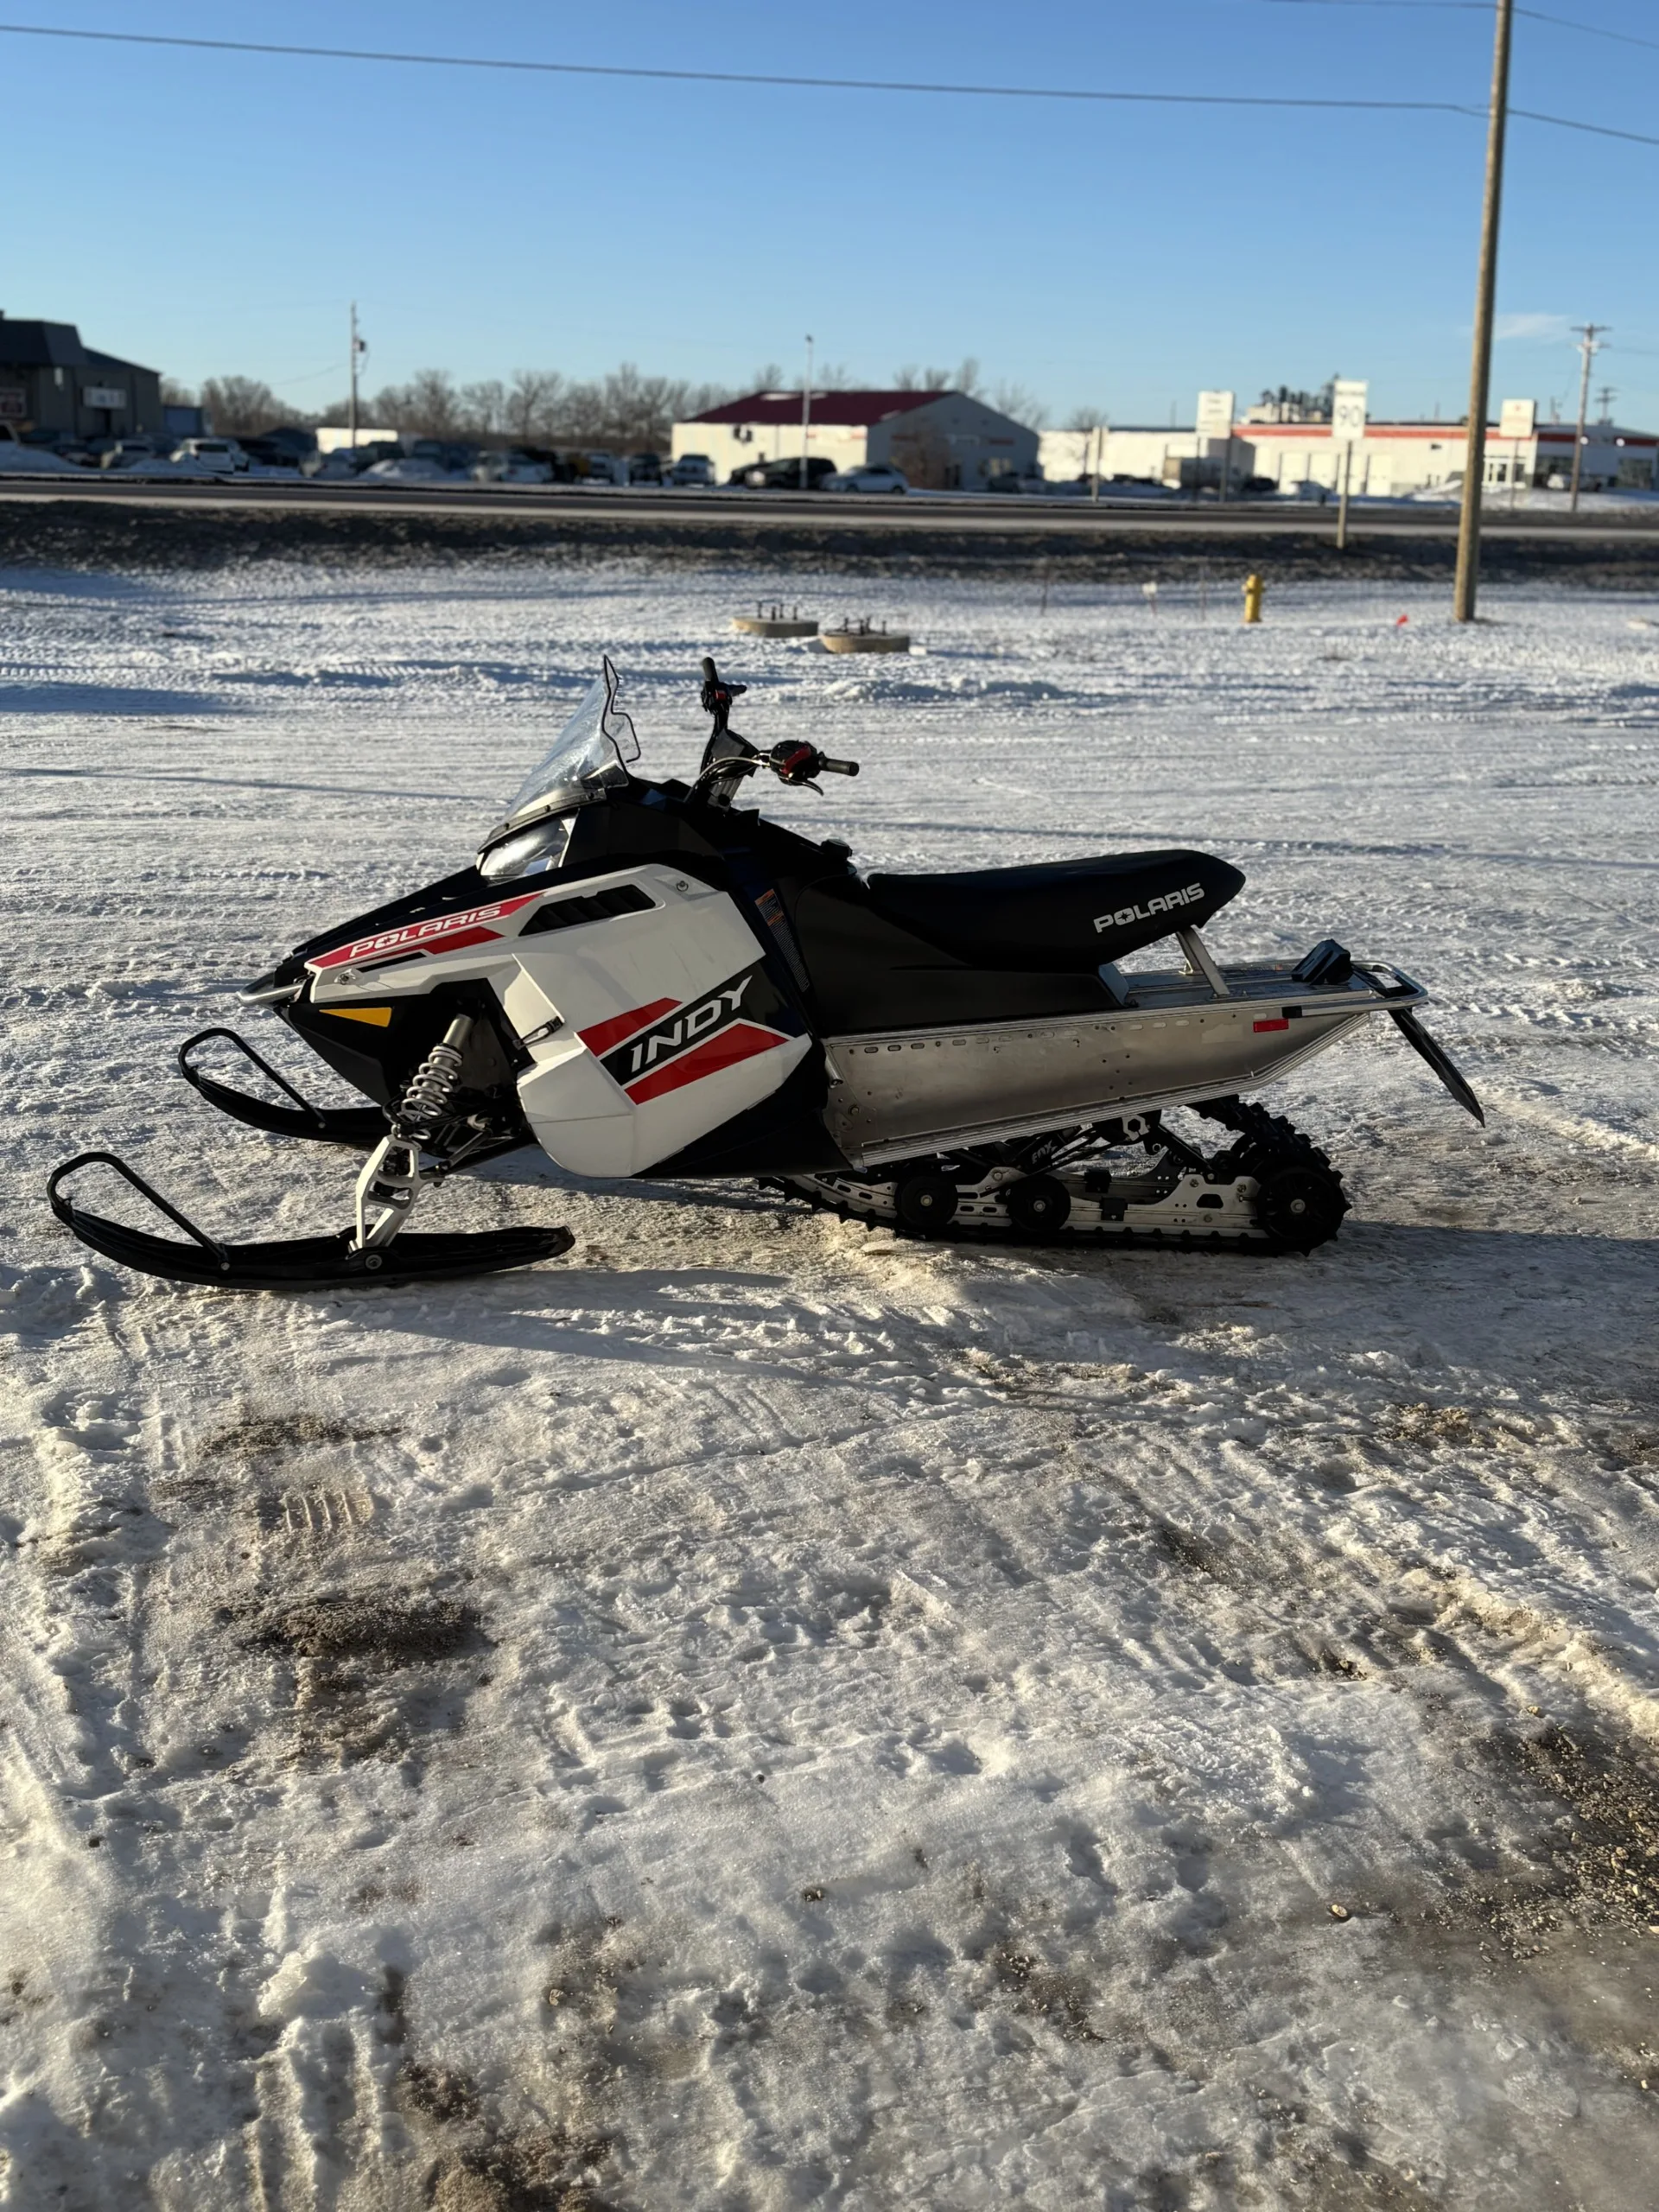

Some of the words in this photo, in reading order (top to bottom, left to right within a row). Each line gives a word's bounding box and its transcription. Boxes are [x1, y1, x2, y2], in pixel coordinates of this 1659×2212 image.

[1337, 404, 1363, 428] 90
[349, 906, 501, 957] POLARIS
[1093, 882, 1205, 933] POLARIS
[631, 975, 753, 1073] INDY
